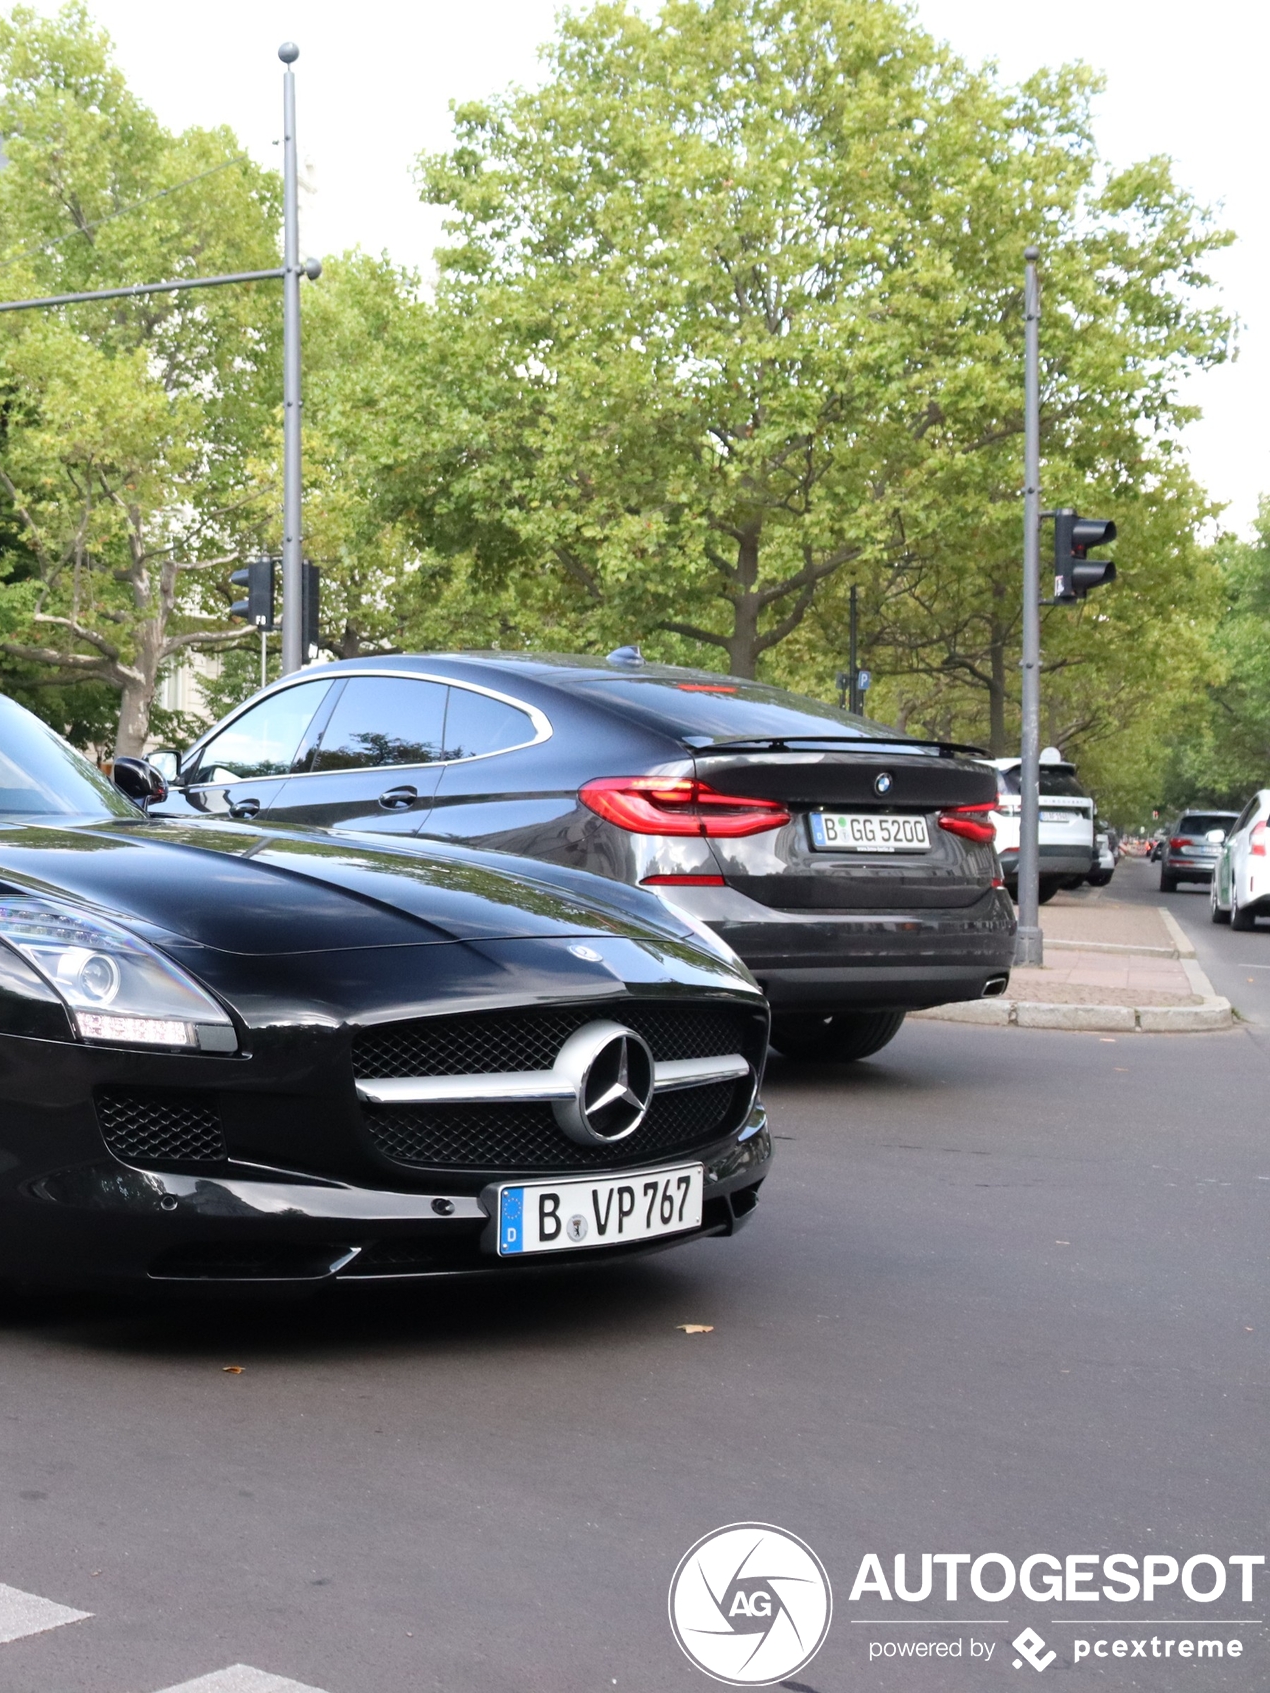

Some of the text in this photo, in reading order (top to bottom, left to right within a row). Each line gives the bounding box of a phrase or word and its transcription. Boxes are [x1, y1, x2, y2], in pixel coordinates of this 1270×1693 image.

[861, 673, 868, 687] P
[825, 818, 926, 843] B GG 5200
[539, 1175, 691, 1242] B VP 767
[507, 1227, 517, 1243] D
